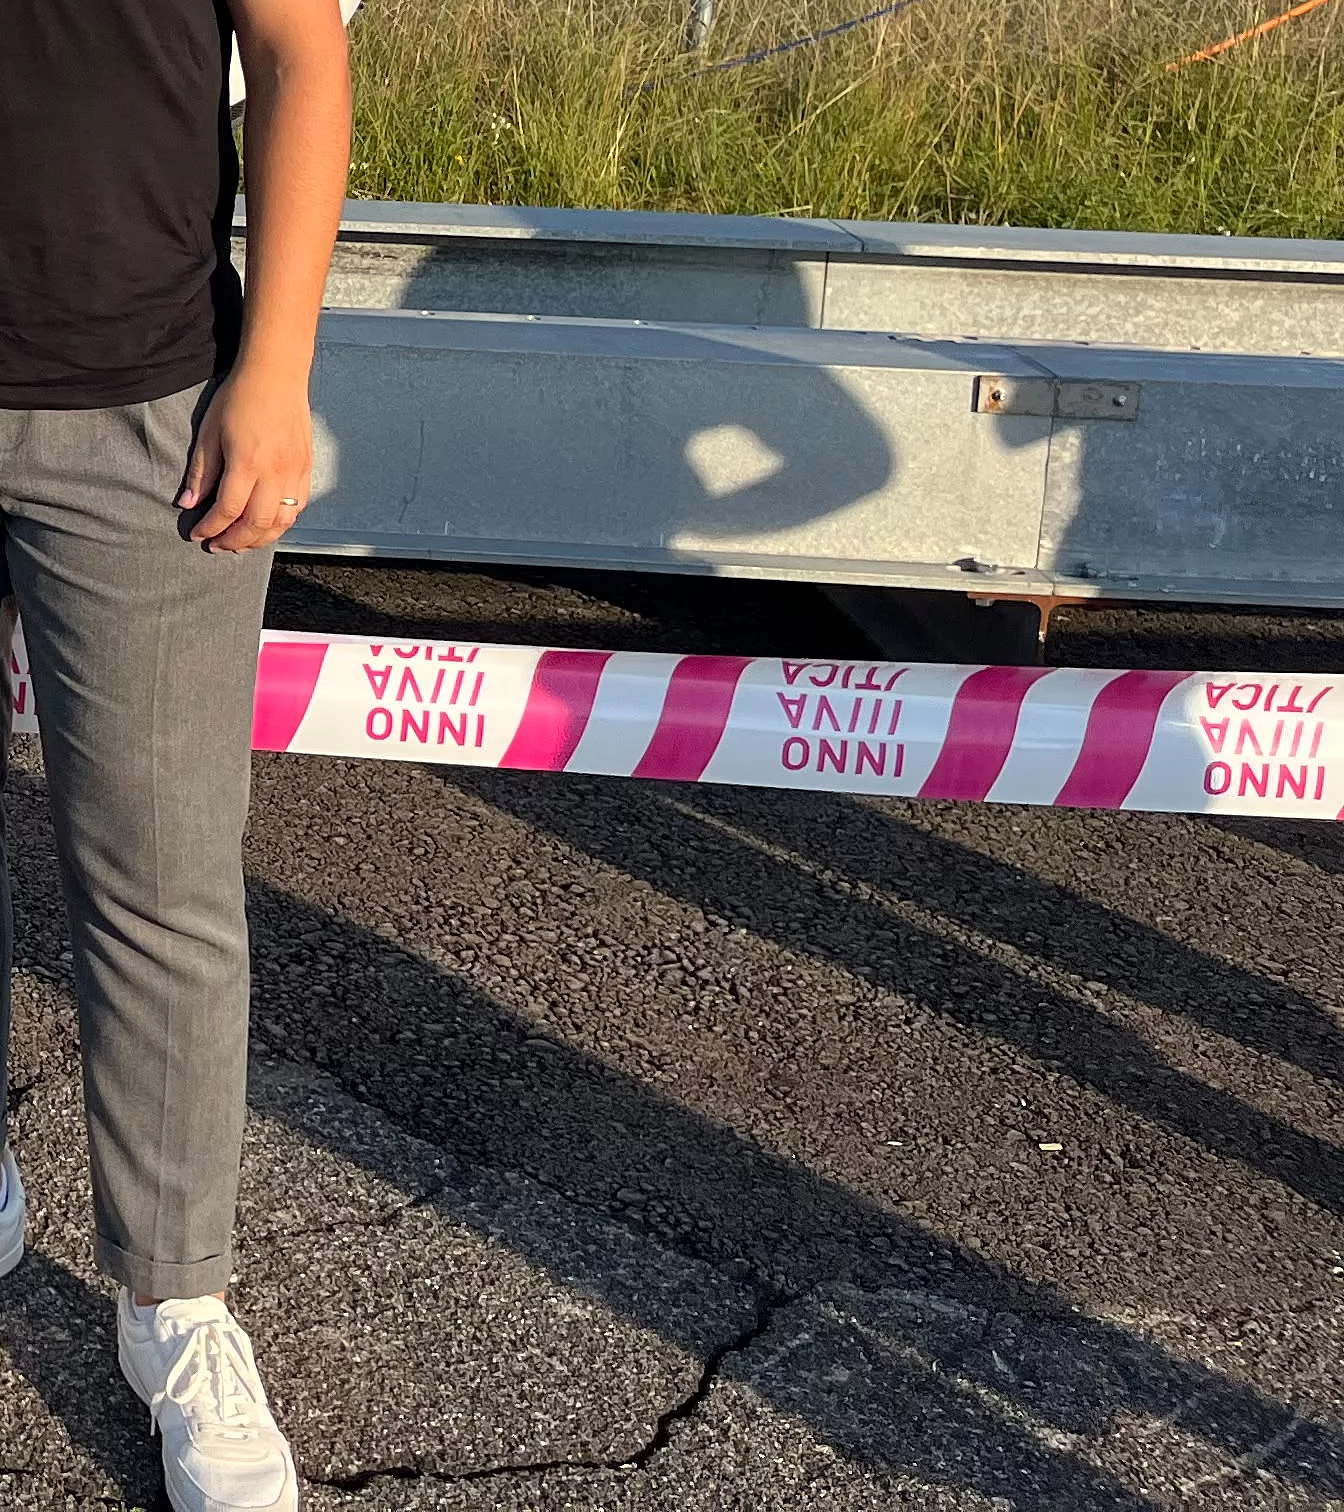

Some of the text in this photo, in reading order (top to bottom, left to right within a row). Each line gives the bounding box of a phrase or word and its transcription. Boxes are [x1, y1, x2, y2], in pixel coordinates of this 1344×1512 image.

[366, 707, 486, 748] INNO
[780, 735, 904, 777] INNO
[1203, 760, 1325, 800] INNO
